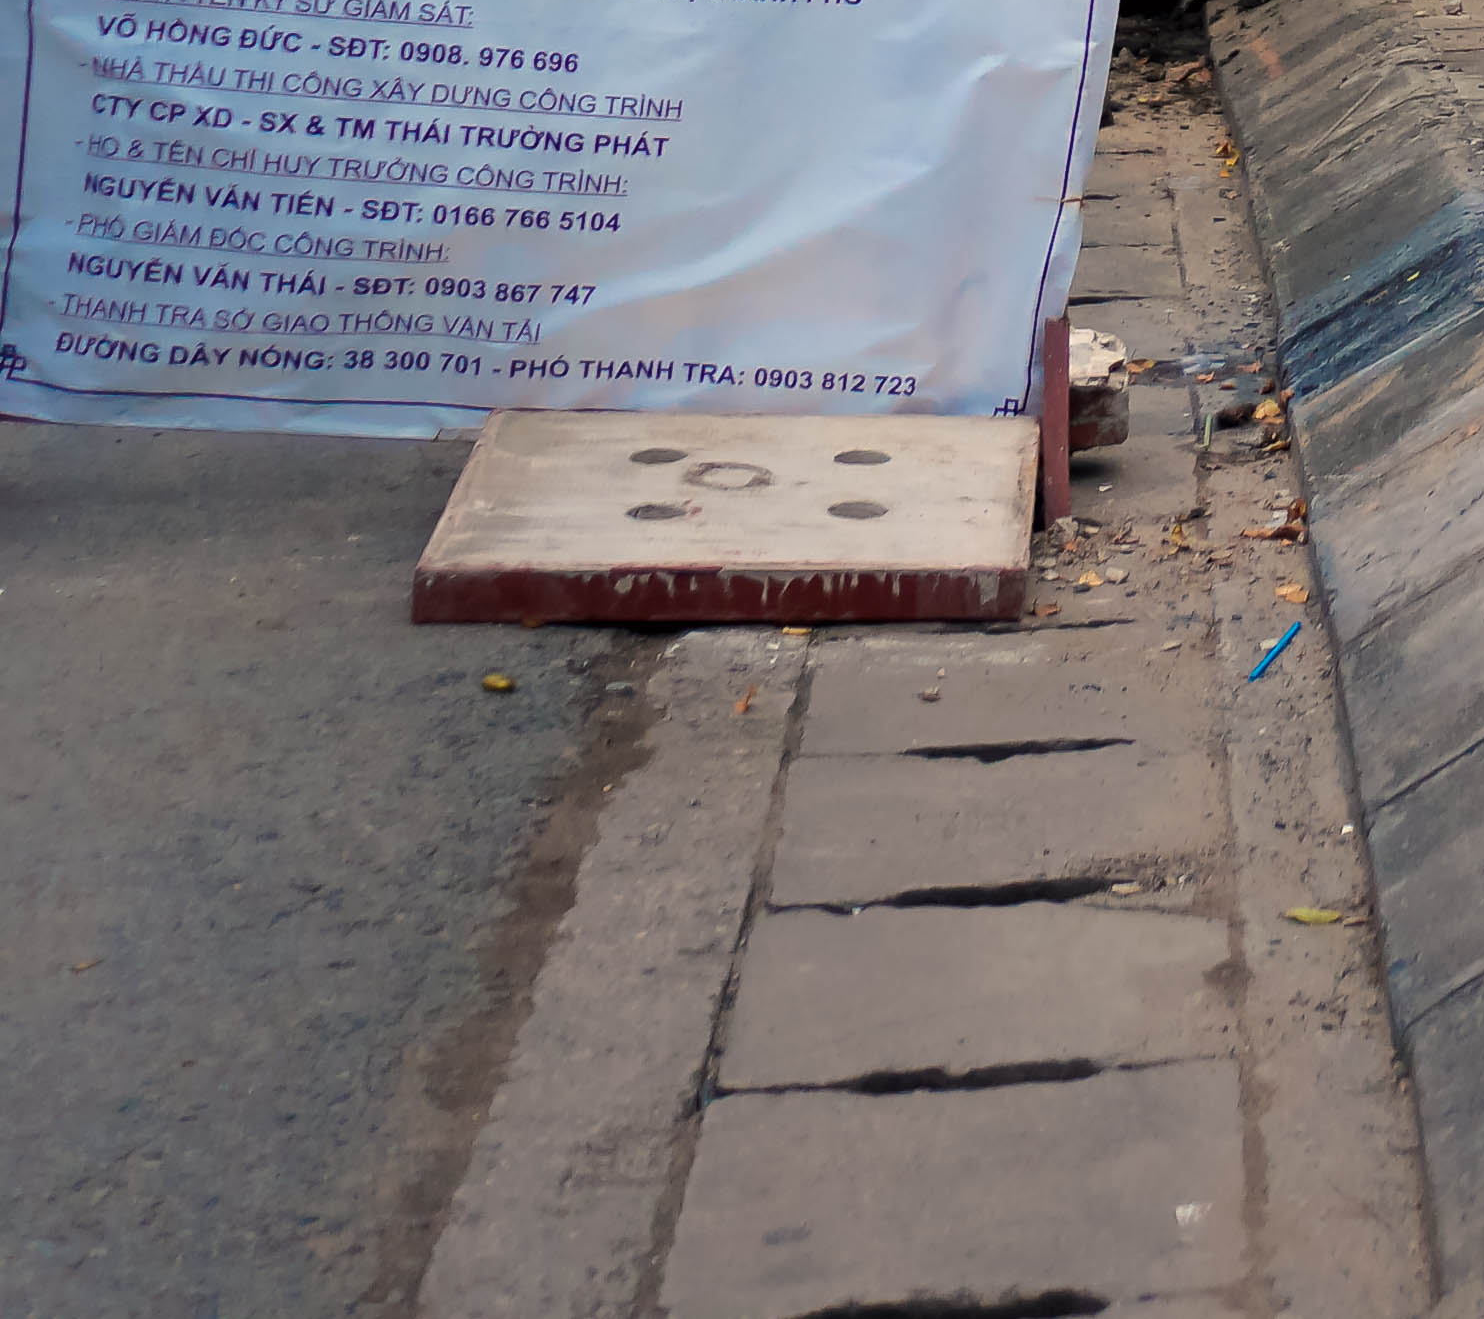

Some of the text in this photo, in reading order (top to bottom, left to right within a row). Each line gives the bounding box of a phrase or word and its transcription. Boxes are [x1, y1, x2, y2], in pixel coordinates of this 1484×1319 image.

[399, 41, 469, 66] 0908.
[479, 46, 525, 70] 976
[533, 51, 579, 74] 696
[233, 69, 275, 91] THI
[92, 93, 143, 119] CTY
[149, 100, 186, 123] CP
[195, 106, 233, 129] XD
[259, 111, 299, 135] SX
[335, 116, 376, 140] TM
[263, 153, 321, 174] HUY
[432, 204, 496, 227] 0166
[505, 208, 551, 230] 766
[559, 210, 621, 233] 5104
[425, 276, 486, 299] 0903
[494, 282, 543, 303] 867
[550, 283, 597, 306] 747
[63, 292, 148, 323] THANH
[156, 303, 206, 329] TRA
[262, 312, 330, 334] GIAO
[343, 349, 374, 370] 38
[383, 350, 431, 371] 300
[440, 352, 481, 376] 701
[579, 359, 674, 381] THANH
[683, 362, 745, 386] TRA:
[754, 367, 813, 391] 0903
[821, 372, 866, 393] 812
[874, 375, 917, 398] 723
